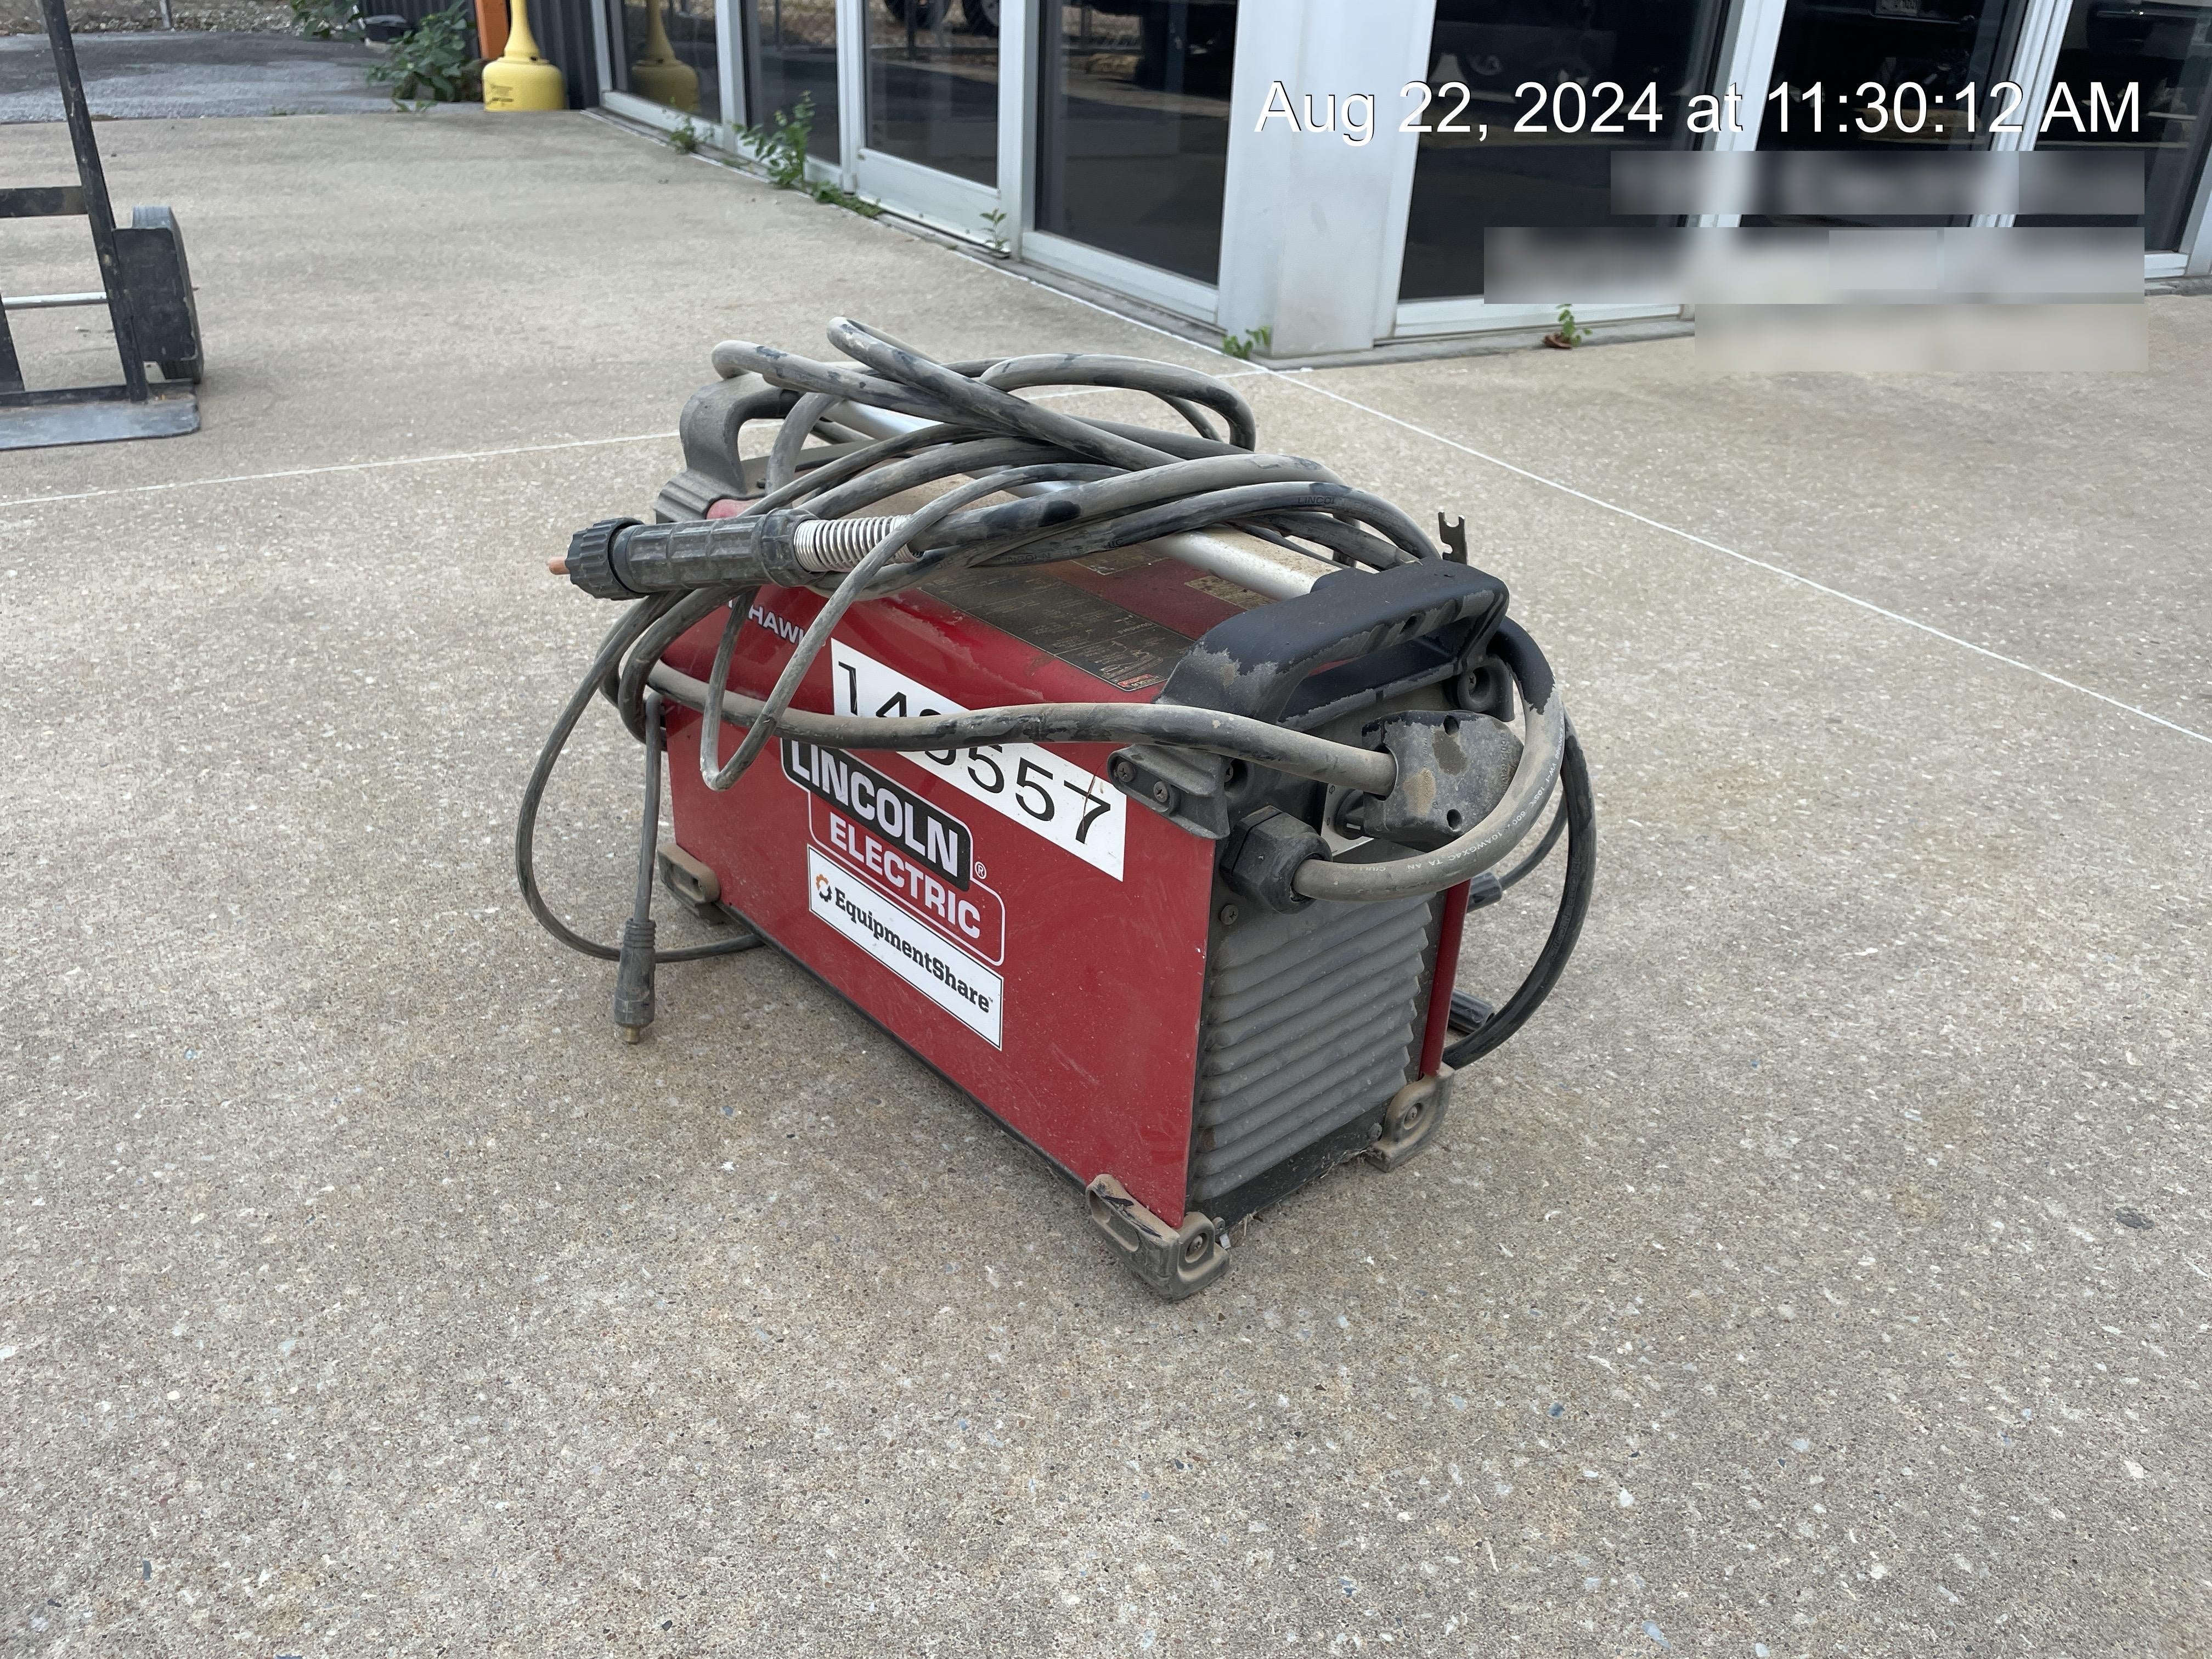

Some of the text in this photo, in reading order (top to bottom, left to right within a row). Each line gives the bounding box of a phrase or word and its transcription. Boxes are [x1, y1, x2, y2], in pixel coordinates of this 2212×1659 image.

[791, 740, 958, 877] LINCOLN
[830, 811, 981, 939] ELECTRIC
[834, 887, 989, 1013] EquipmentShare
